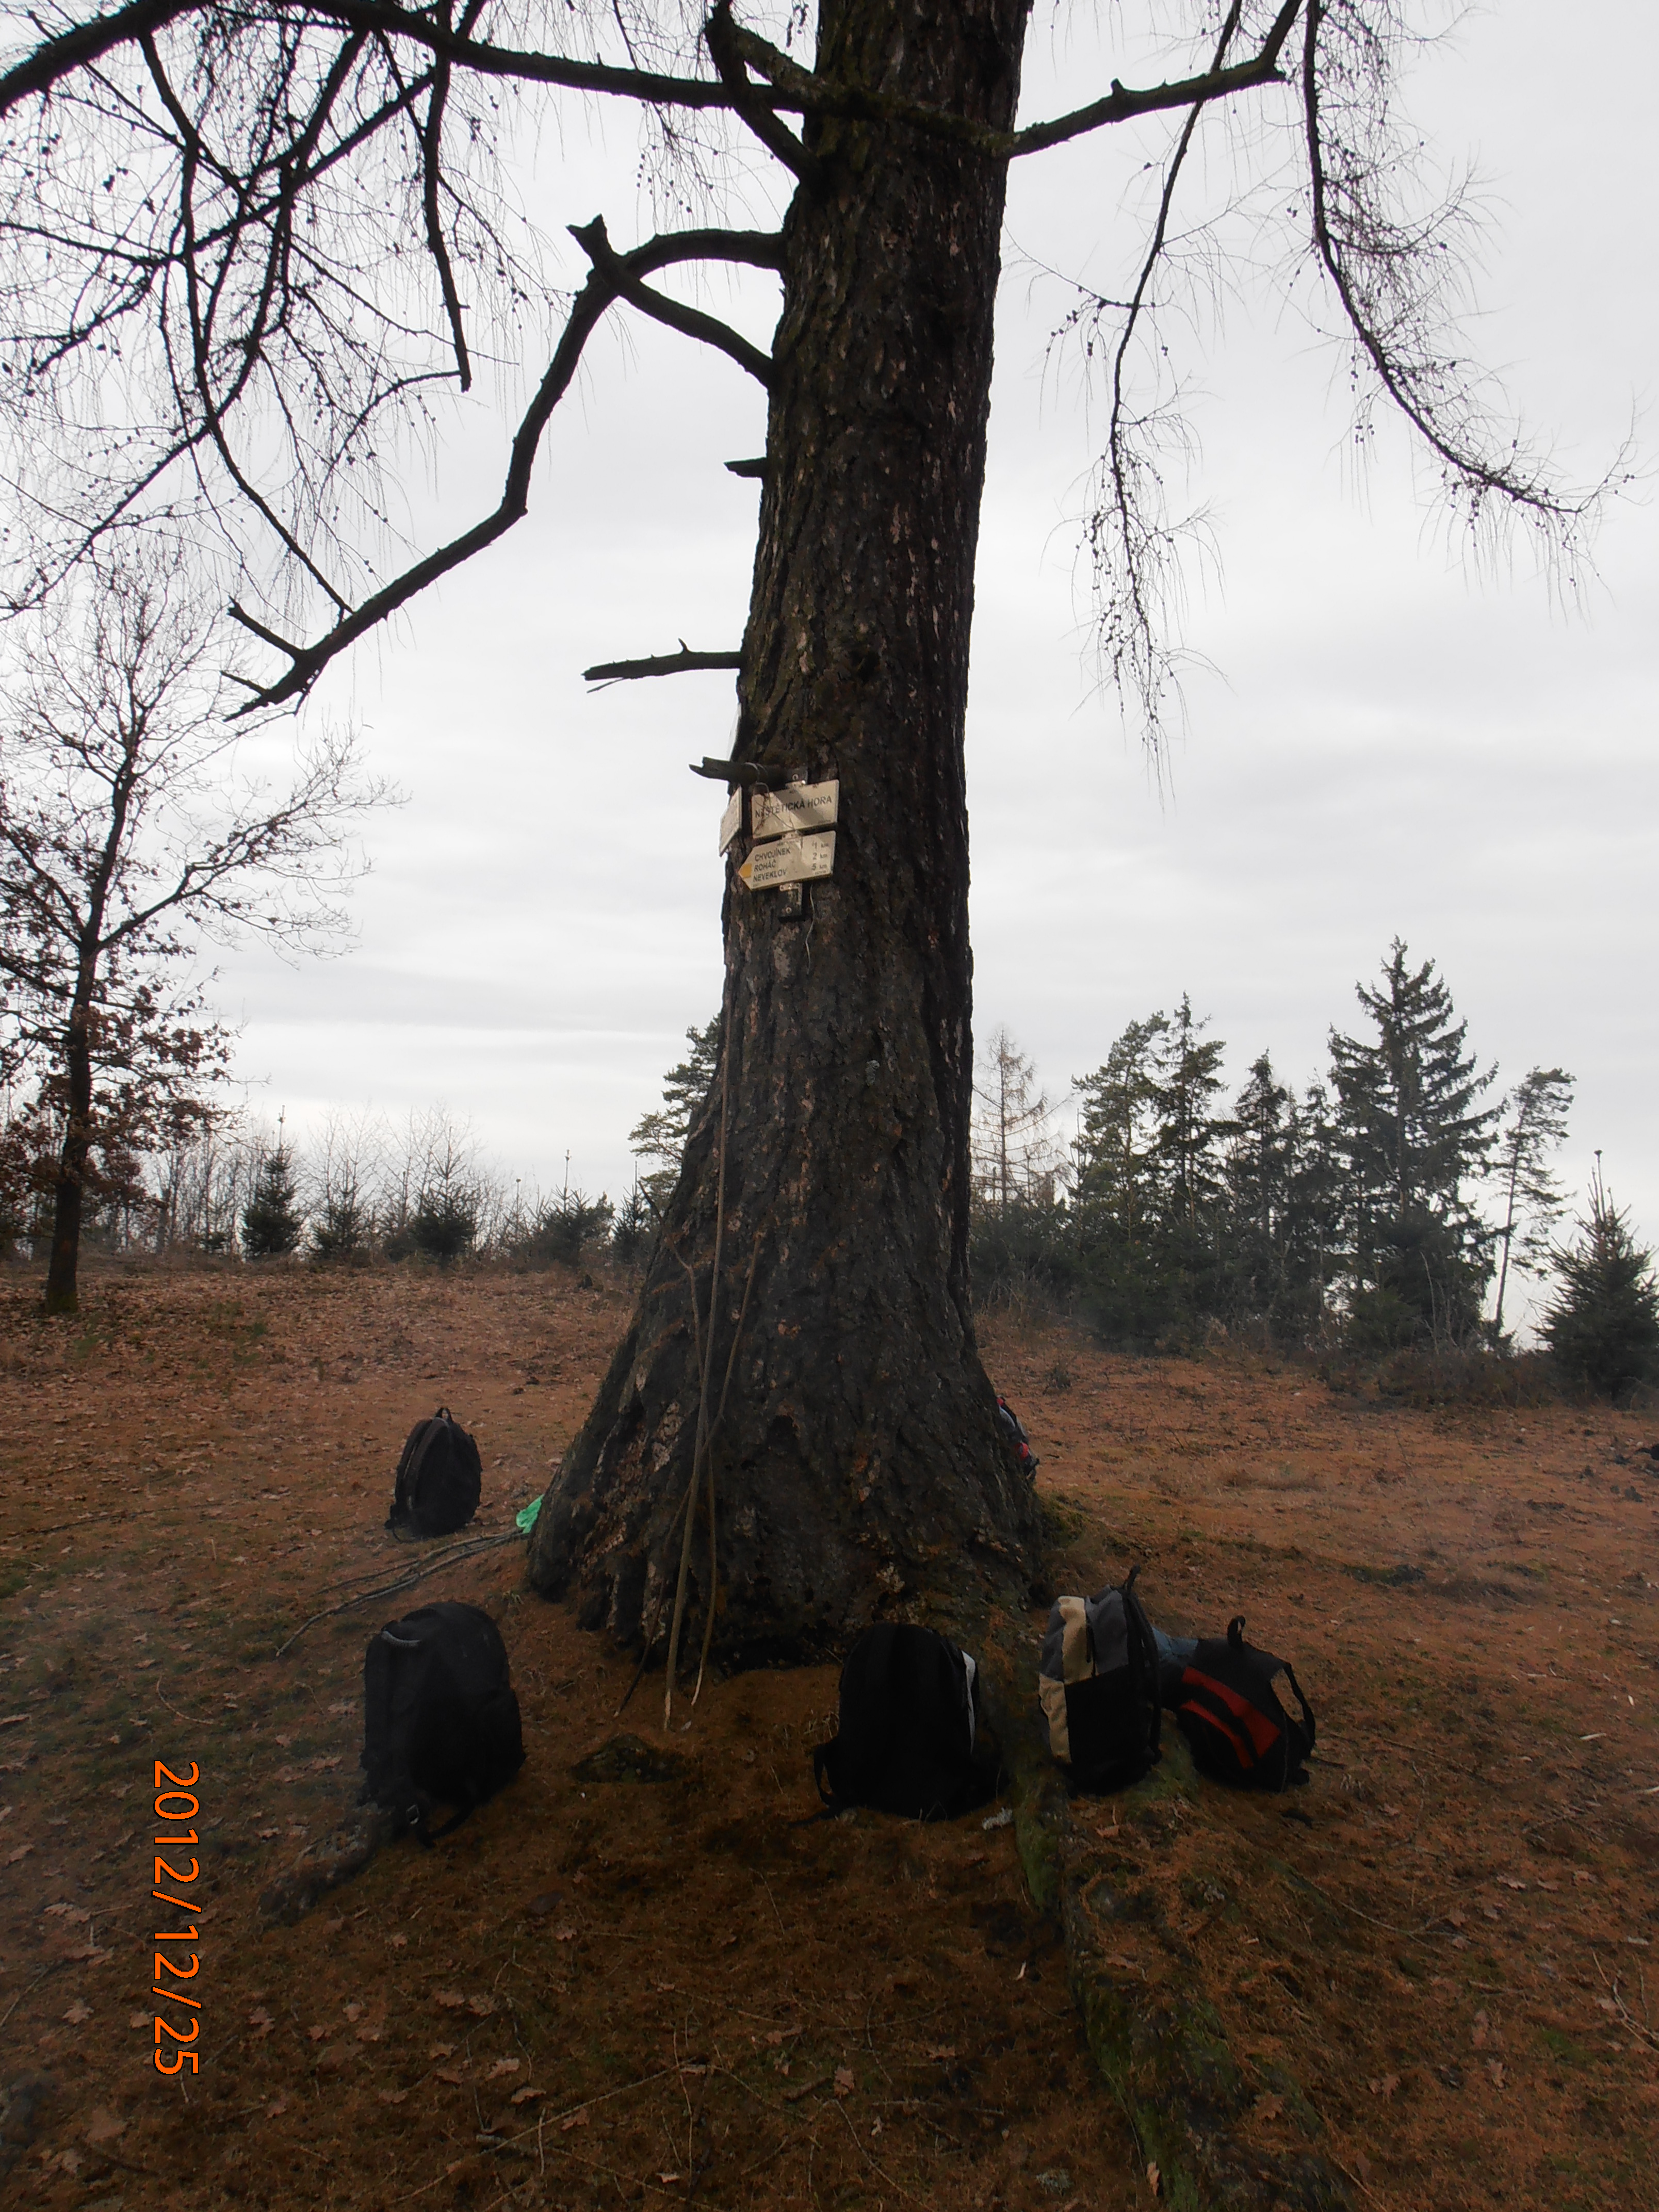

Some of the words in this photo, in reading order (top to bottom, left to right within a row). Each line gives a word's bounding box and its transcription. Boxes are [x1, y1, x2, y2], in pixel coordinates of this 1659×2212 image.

[807, 795, 832, 808] HORA
[754, 847, 791, 861] CHVOJÍNEK
[753, 869, 787, 882] NEVEKLOV
